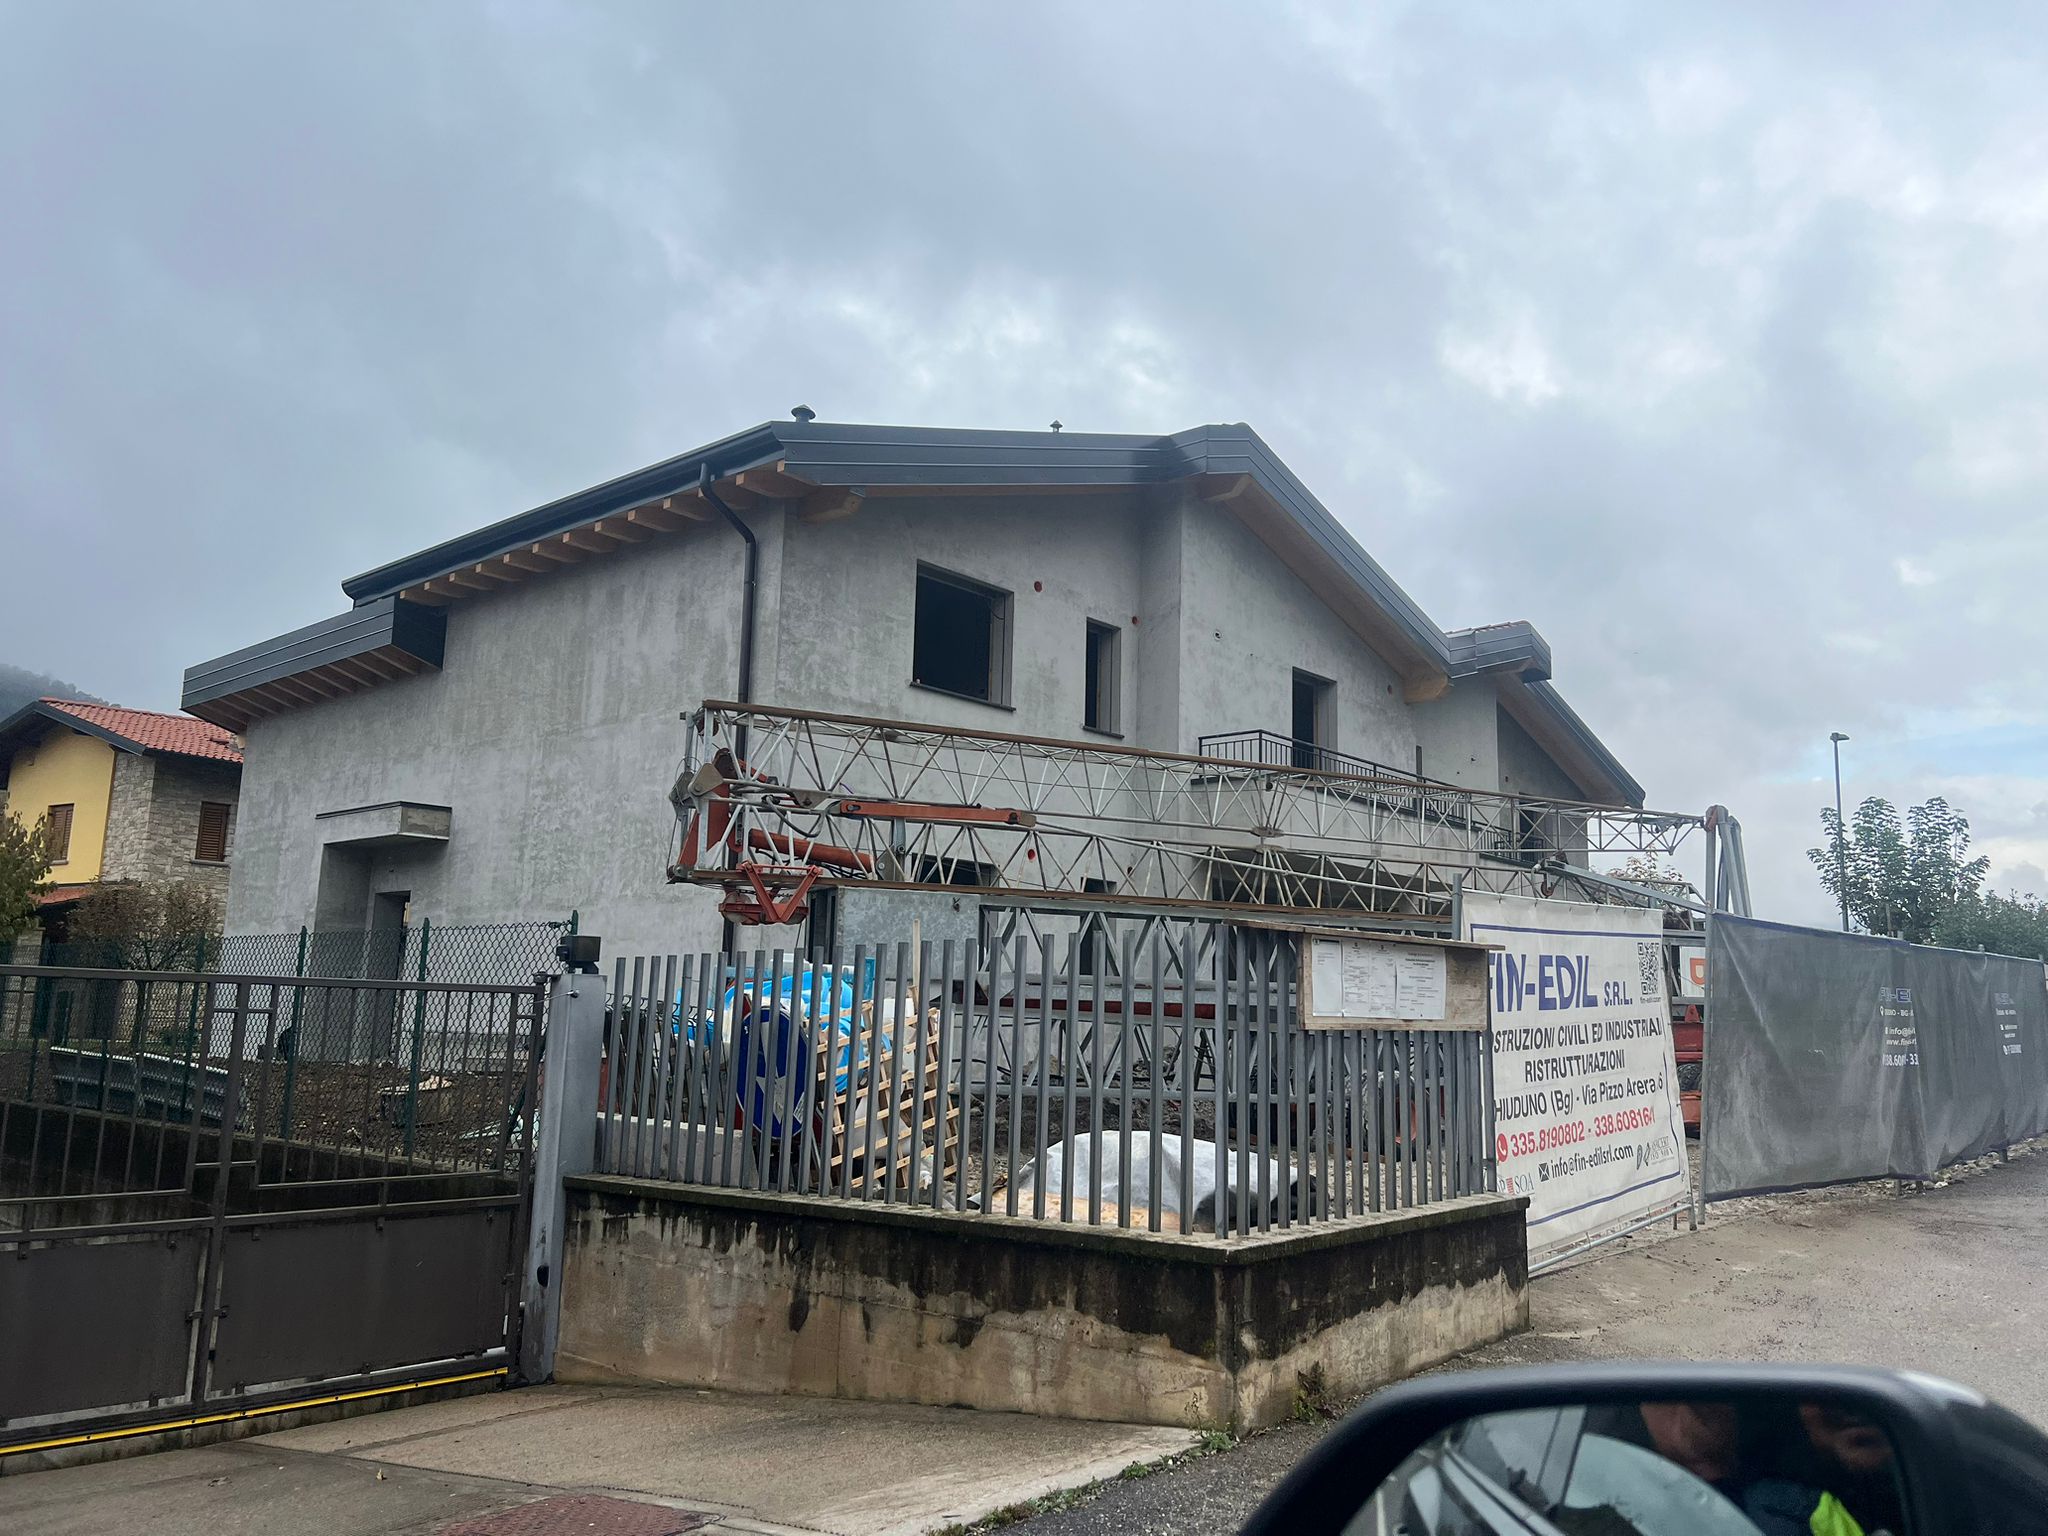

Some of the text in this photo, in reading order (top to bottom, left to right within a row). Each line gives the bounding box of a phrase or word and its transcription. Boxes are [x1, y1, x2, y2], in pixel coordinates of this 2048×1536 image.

[1604, 981, 1633, 1006] S.R.L.
[1494, 1028, 1555, 1053] STRUZIONI
[1558, 1023, 1589, 1047] CIVILI
[1592, 1022, 1603, 1043] ED
[1525, 1049, 1625, 1083] RISTRUTTURAZIONI
[1551, 1088, 1574, 1117] (Bg)
[1582, 1084, 1597, 1105] Via
[1600, 1080, 1624, 1102] Pizzo
[1627, 1078, 1656, 1097] Arera
[1511, 1120, 1585, 1157] 335.8190802
[1551, 1144, 1634, 1179] info@fin-edilsrl.com
